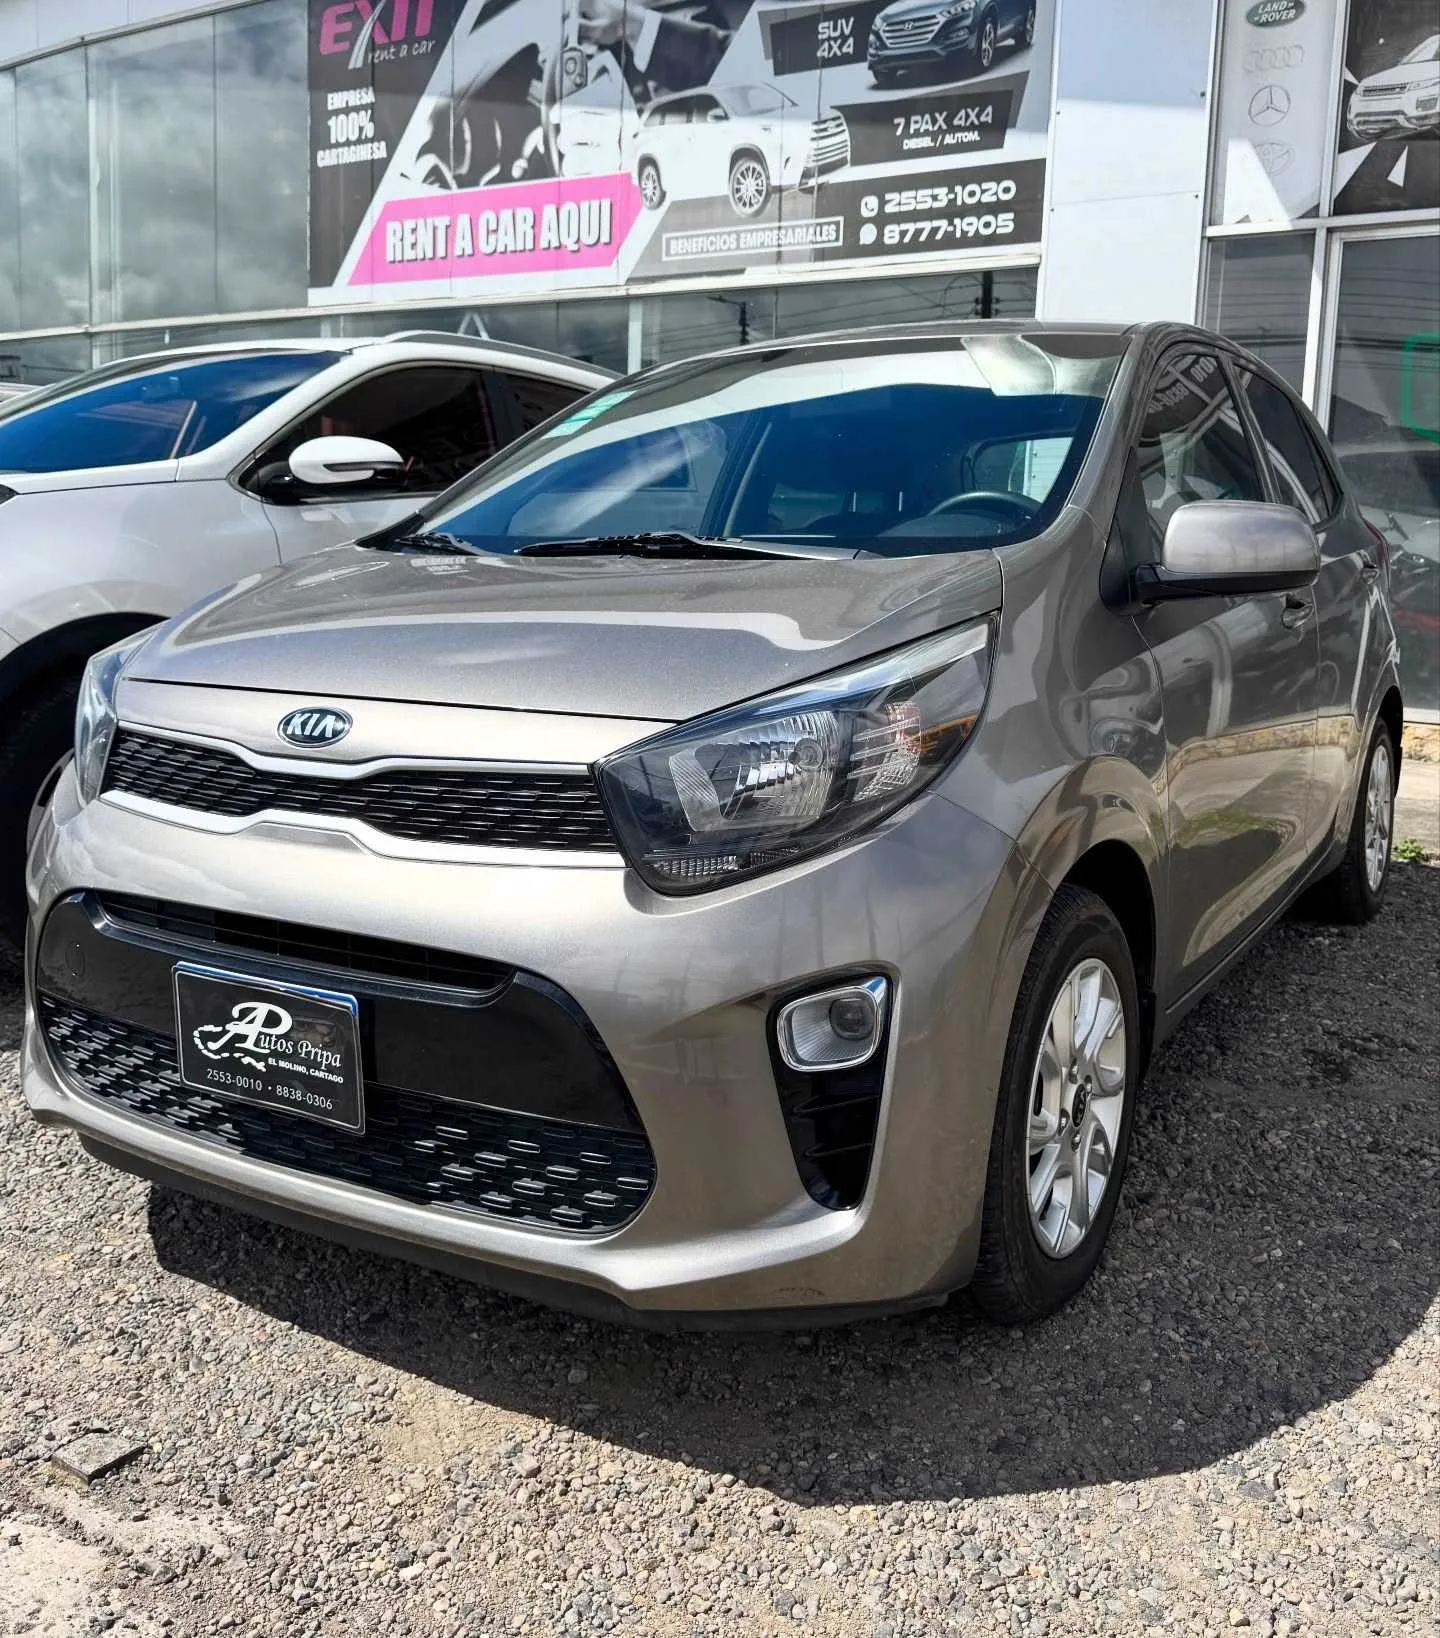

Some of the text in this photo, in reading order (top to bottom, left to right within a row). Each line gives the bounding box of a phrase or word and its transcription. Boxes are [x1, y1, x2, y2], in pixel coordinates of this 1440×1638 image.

[818, 16, 855, 40] SUV
[367, 39, 436, 63] rent a car
[816, 36, 855, 59] 4X4
[327, 87, 376, 110] EMPRESA
[327, 109, 375, 144] 100%
[893, 105, 993, 136] 7 PAX 4X4
[902, 136, 935, 150] DIESEL
[943, 130, 981, 145] AUTOM.
[316, 141, 387, 168] CARTAGINESA
[884, 179, 1017, 214] 2553-1020
[385, 198, 613, 263] RENT A CAR AQUI
[670, 223, 838, 255] BENEFICIOS EMPRESARIALES
[883, 211, 1016, 245] 8777-1905
[286, 713, 336, 738] KIA
[297, 1040, 342, 1070] Pripa
[267, 1057, 278, 1066] EL
[309, 1068, 344, 1084] CARTAGO
[206, 1068, 334, 1110] 2553-0010 8838-0306
